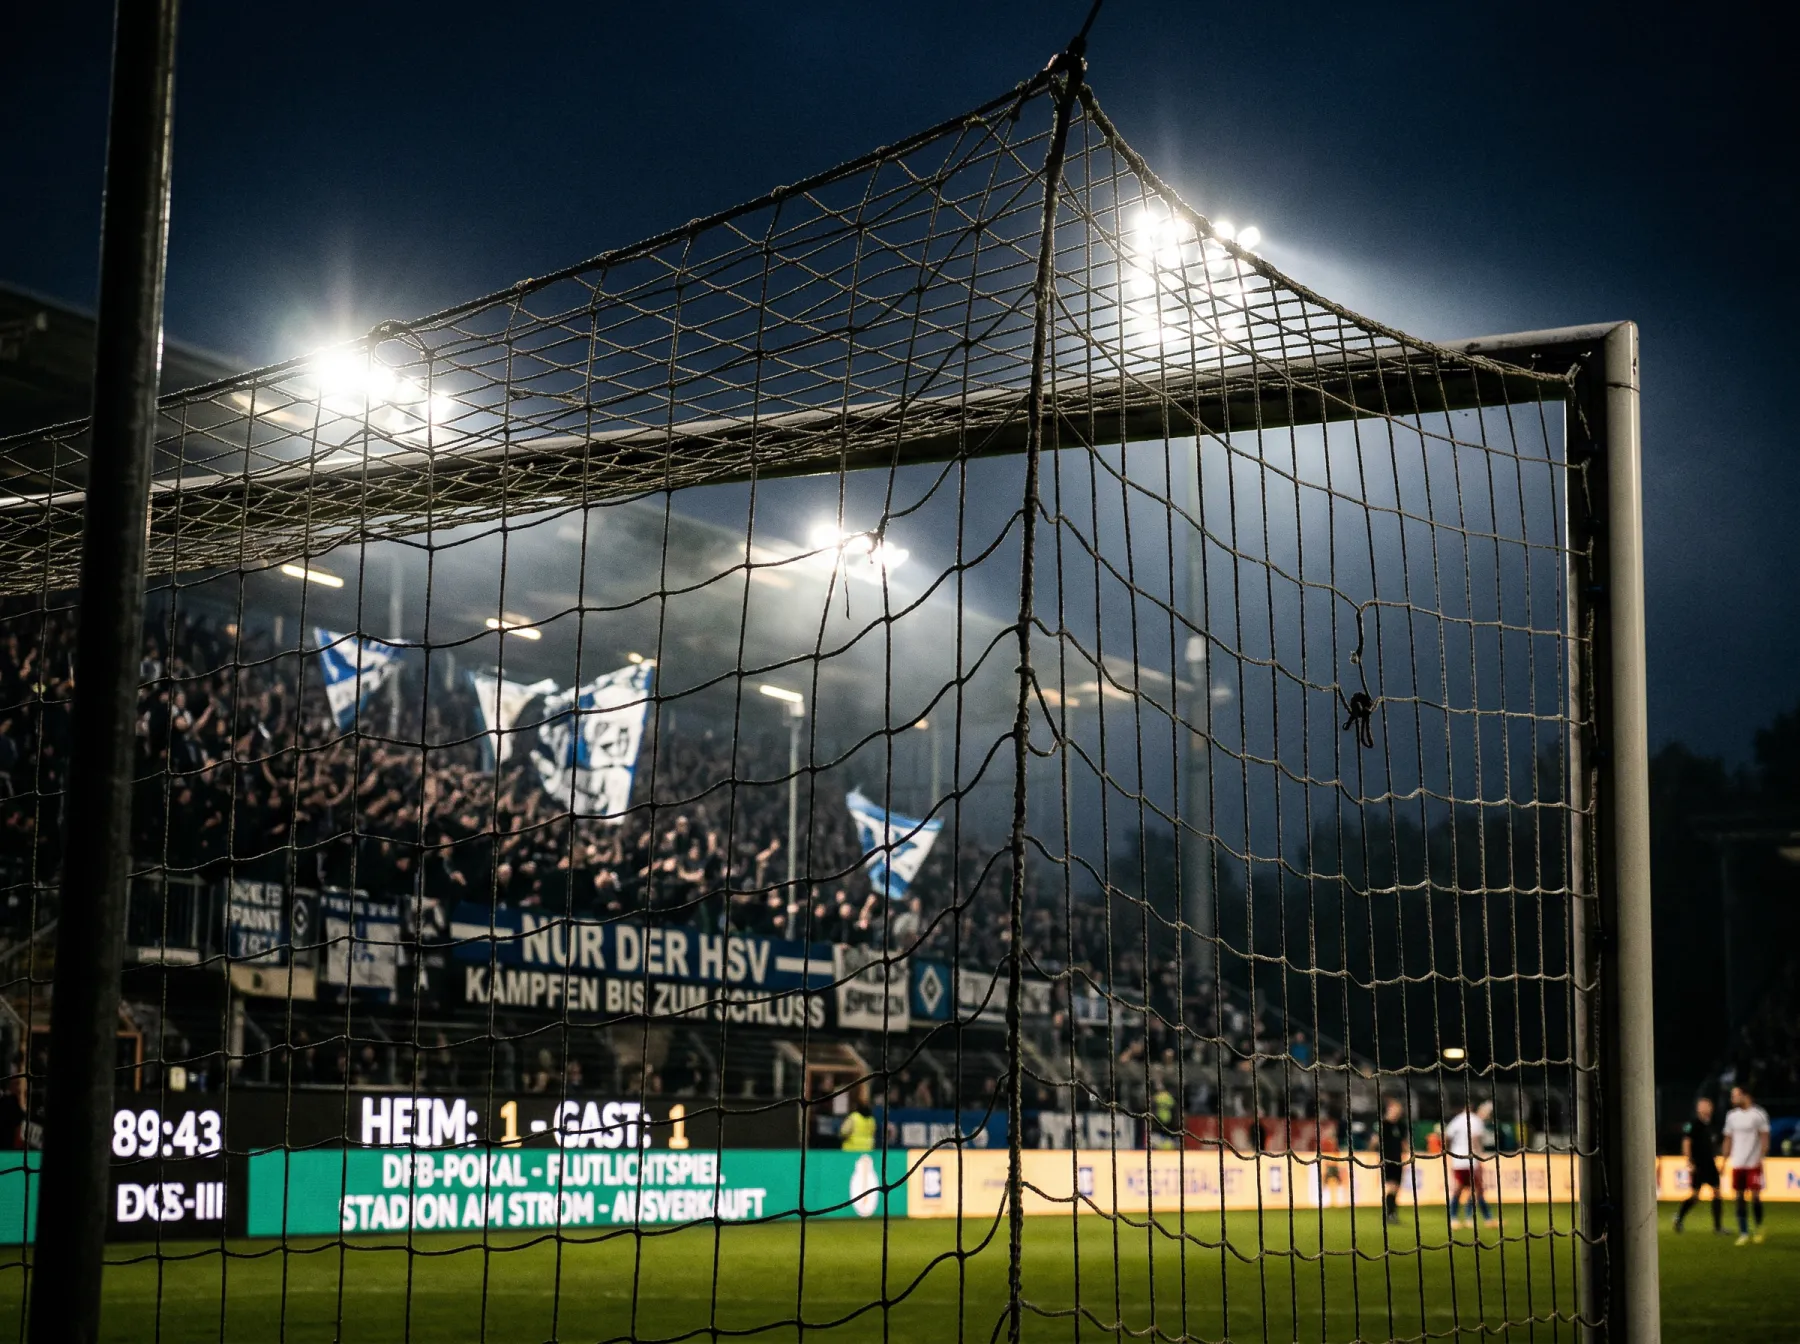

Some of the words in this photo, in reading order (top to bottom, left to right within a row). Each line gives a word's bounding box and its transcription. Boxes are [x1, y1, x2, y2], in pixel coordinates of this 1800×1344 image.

[521, 913, 606, 970] NUR
[615, 924, 690, 977] DER
[699, 933, 770, 984] HSV
[465, 961, 599, 1012] KÄMPFEN
[605, 978, 646, 1014] BIS
[653, 982, 708, 1019] ZUM
[713, 988, 826, 1029] SCHLUSS
[112, 1109, 222, 1158] 89:43
[361, 1096, 478, 1148] HEIM:
[500, 1100, 523, 1148] 1
[553, 1100, 652, 1149] GAST:
[668, 1103, 690, 1149] 1
[382, 1153, 528, 1188] DFB-POKAL
[546, 1153, 726, 1186] FLUTLICHTSPIEL
[338, 1193, 458, 1231] STADION
[461, 1192, 504, 1227] AM
[507, 1191, 595, 1226] STROM
[611, 1187, 767, 1223] AUSVERKAUFT
